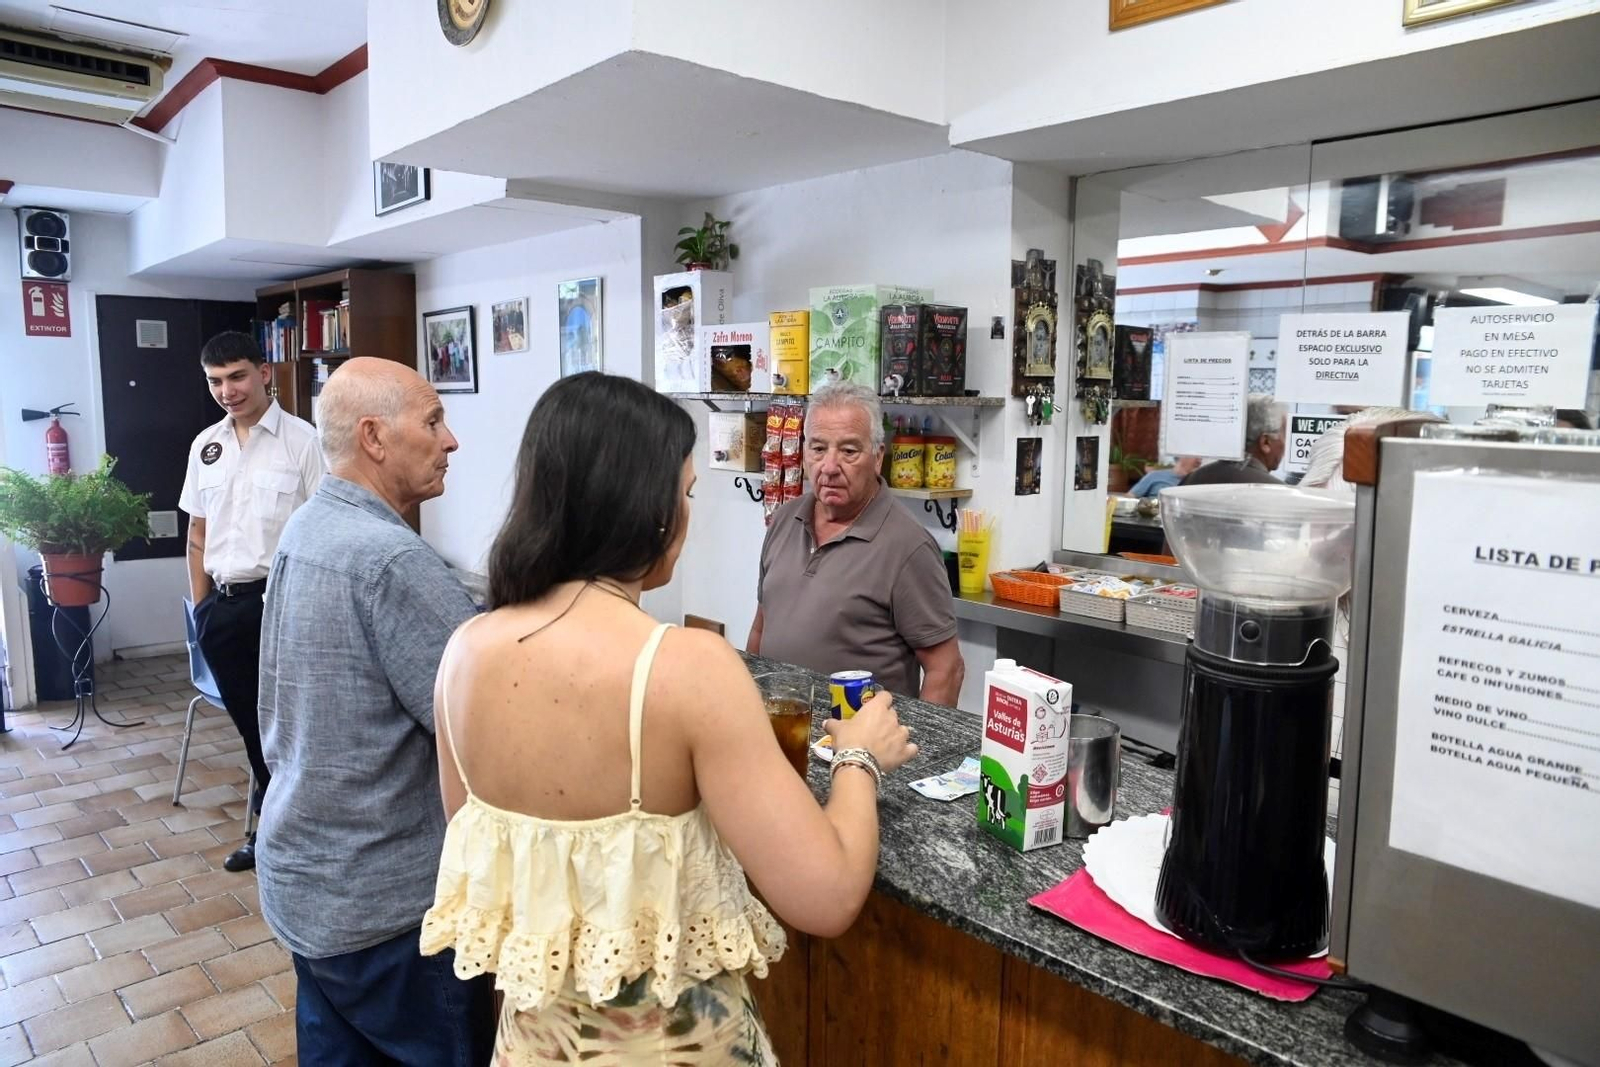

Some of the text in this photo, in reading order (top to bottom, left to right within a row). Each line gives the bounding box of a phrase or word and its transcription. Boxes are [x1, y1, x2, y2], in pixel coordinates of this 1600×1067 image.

[1470, 313, 1554, 324] AUTOSERVICIO
[712, 331, 752, 343] Zafra Moreno
[1296, 328, 1328, 338] DETRÁS
[1356, 330, 1386, 338] BARRA
[1484, 332, 1535, 341] EN MESA
[816, 336, 865, 348] CAMPITO
[1335, 344, 1382, 352] EXCLUSIVO
[1460, 349, 1558, 358] PAGO EN EFECTIVO
[1316, 371, 1359, 380] DIRECTIVA
[1466, 365, 1548, 374] NO SE ADMITEN
[1482, 380, 1529, 389] TARJETAS
[1298, 419, 1315, 432] WE
[1296, 438, 1317, 447] CA
[1475, 546, 1539, 566] LISTA
[1549, 555, 1580, 571] DE
[1442, 624, 1504, 642] ESTRELLA
[1438, 656, 1502, 675] REFRECOS
[1506, 668, 1514, 676] Y
[1437, 668, 1466, 681] CAFE
[1434, 694, 1472, 709] MEDIO
[1476, 704, 1492, 713] DE
[994, 710, 1021, 728] Valles de
[1434, 707, 1462, 720] VINO
[988, 718, 1025, 742] Asturias
[1432, 732, 1484, 751] BOTELLA
[1488, 746, 1522, 761] AGUA
[1430, 744, 1482, 764] BOTELLA
[1486, 759, 1522, 774] AGUA
